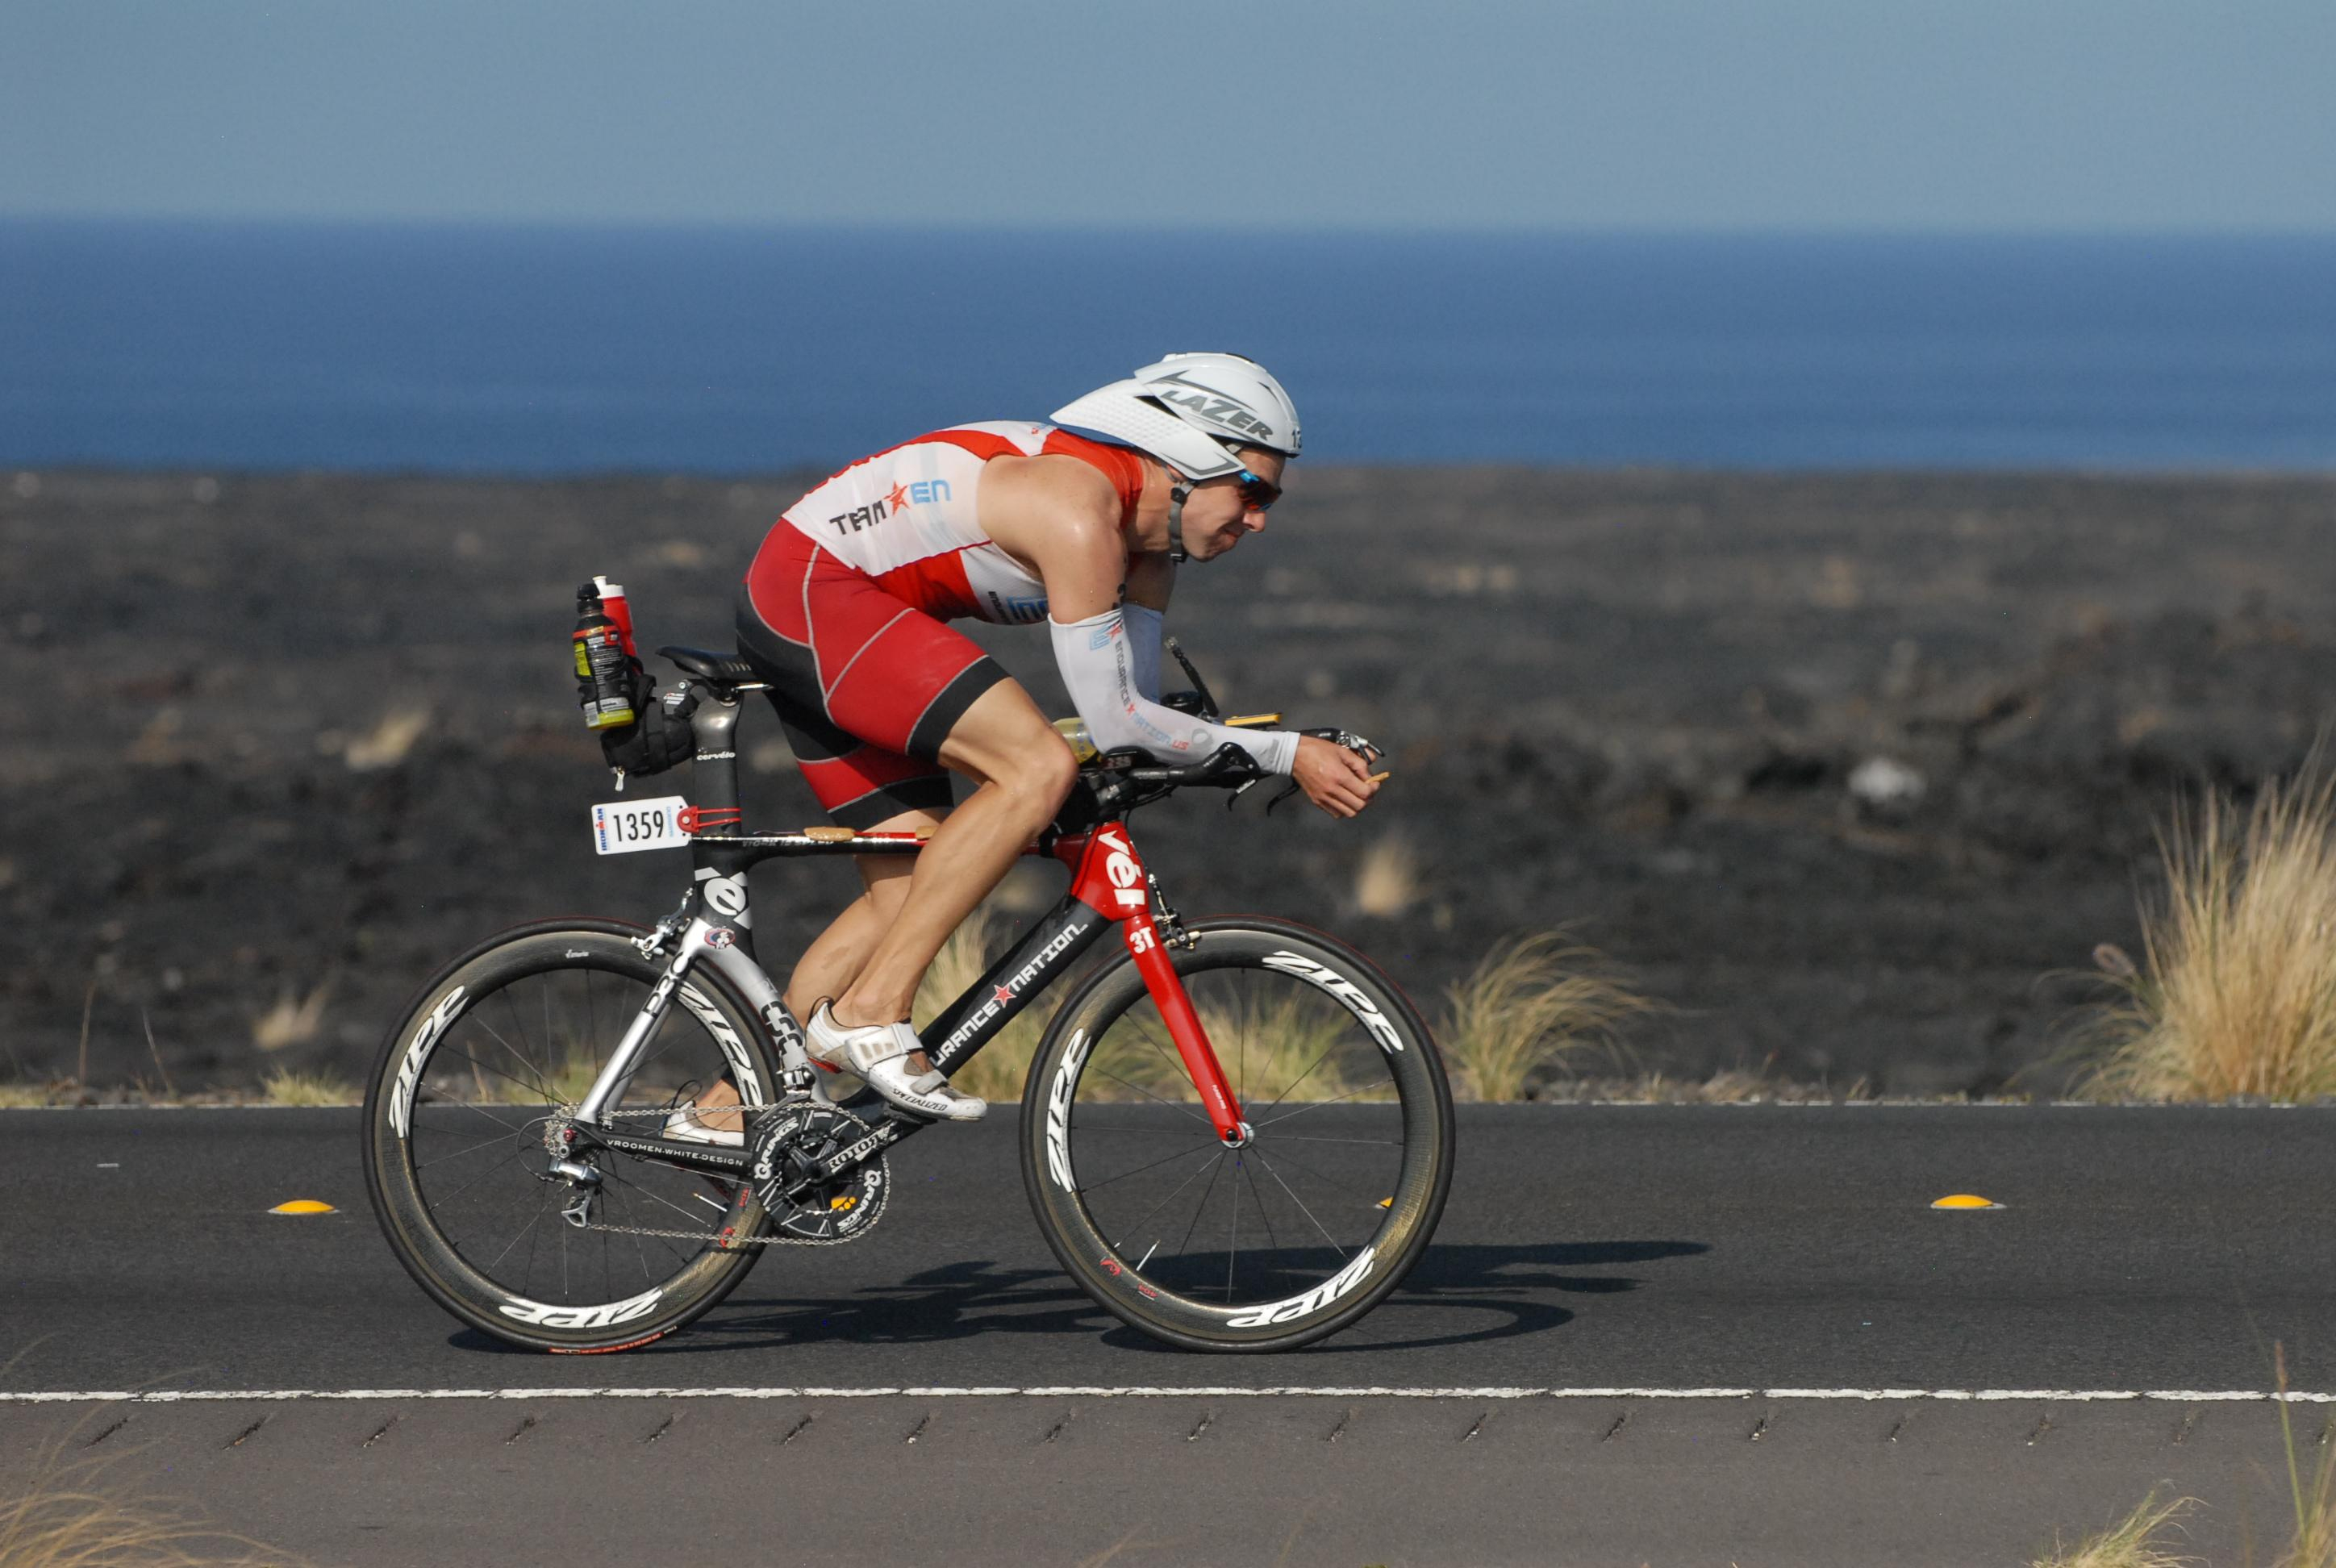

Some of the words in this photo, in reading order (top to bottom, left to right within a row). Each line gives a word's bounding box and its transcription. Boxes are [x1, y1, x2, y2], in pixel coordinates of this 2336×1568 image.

[1160, 390, 1274, 441] LAZER
[829, 500, 886, 535] TEAM
[910, 479, 951, 505] EN
[597, 807, 607, 851] IRONMAN
[613, 810, 664, 842] 1359
[1129, 927, 1155, 954] 3T
[1262, 950, 1404, 1053] ZIPP
[388, 985, 469, 1139] ZIPP
[892, 1088, 949, 1111] SPECIALIZED
[1046, 1028, 1091, 1193] ZIPP
[498, 1287, 664, 1328] ZIPP
[1226, 1245, 1375, 1328] ZIPP
